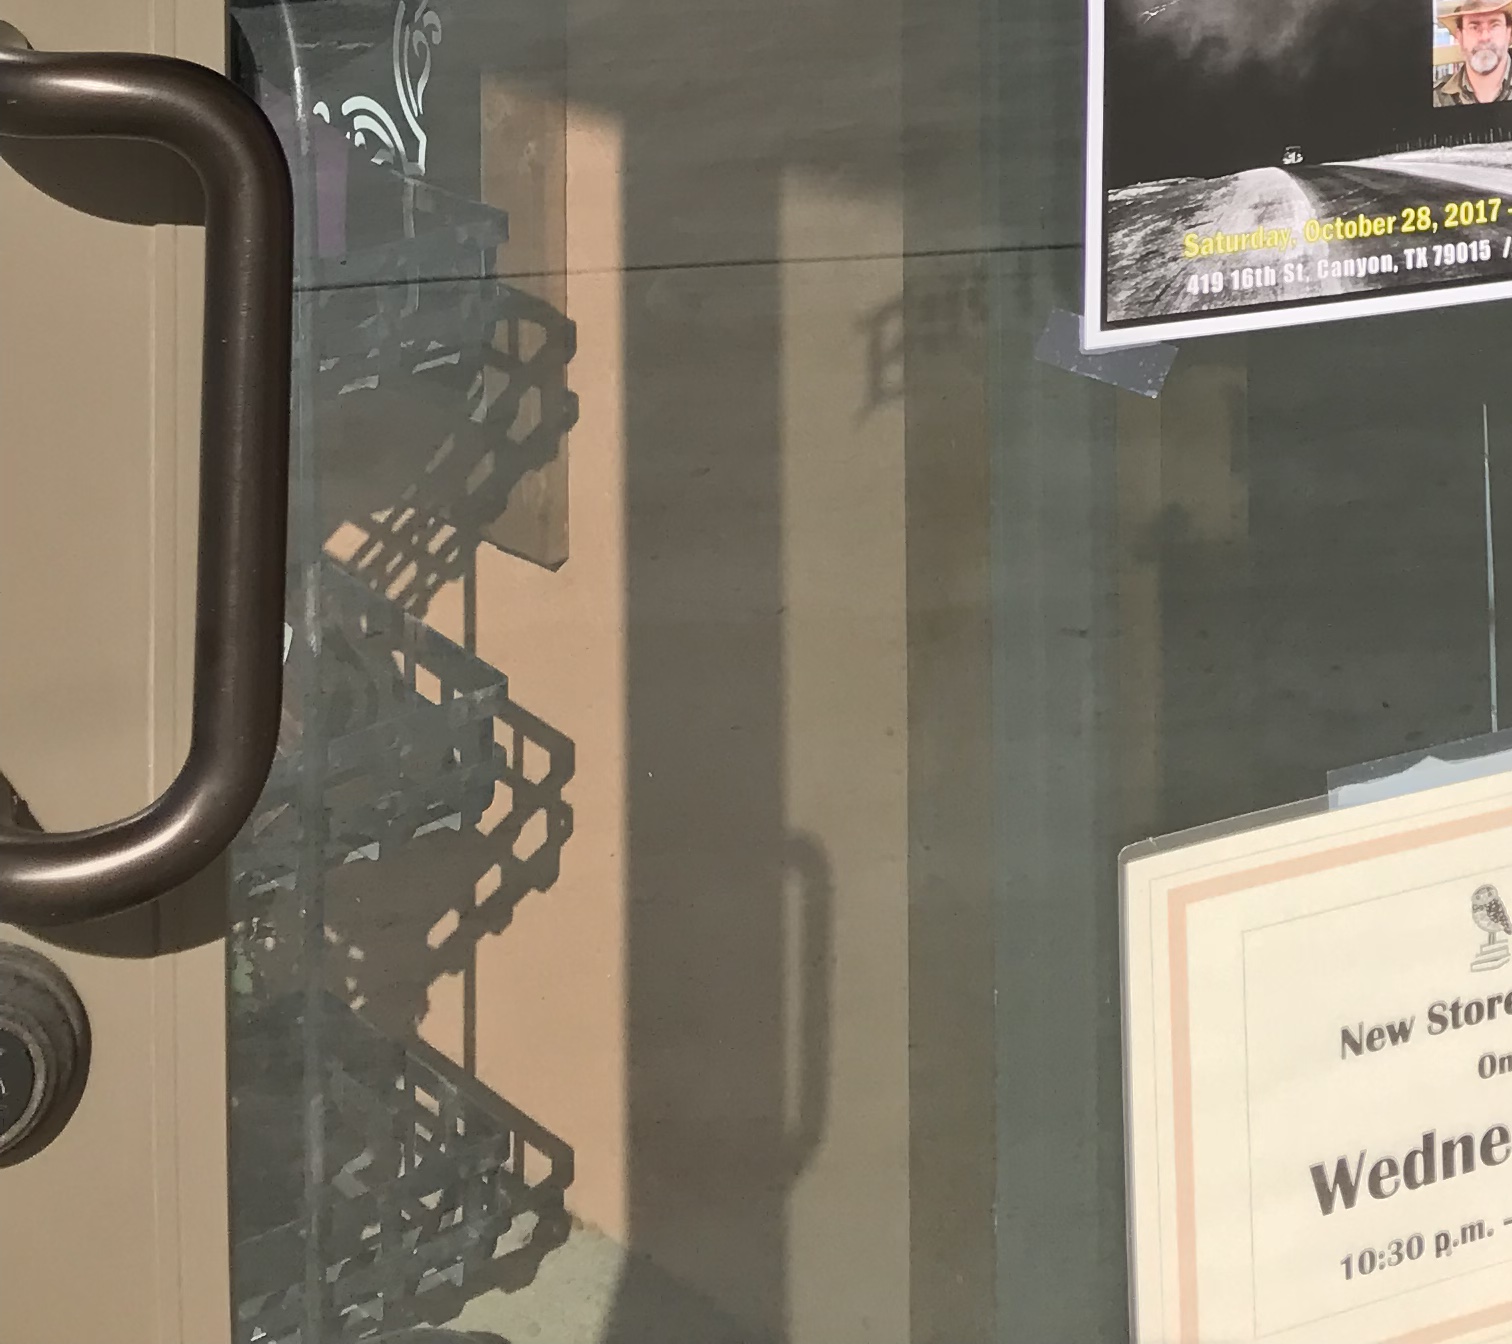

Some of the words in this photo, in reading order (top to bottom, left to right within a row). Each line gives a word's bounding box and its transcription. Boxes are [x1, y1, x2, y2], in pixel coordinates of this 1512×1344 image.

[1183, 225, 1297, 258] Saturday,
[1304, 213, 1397, 243] October
[1401, 205, 1438, 234] 28,
[1444, 198, 1502, 228] 2017
[1187, 272, 1224, 295] 419
[1231, 265, 1277, 290] 16th
[1317, 253, 1399, 280] Canyon,
[1403, 246, 1428, 270] TX
[1433, 239, 1492, 266] 79015
[1503, 236, 1512, 259] /
[1340, 1015, 1416, 1060] New
[1340, 1232, 1425, 1280] 10:30
[1434, 1219, 1495, 1258] p.m.
